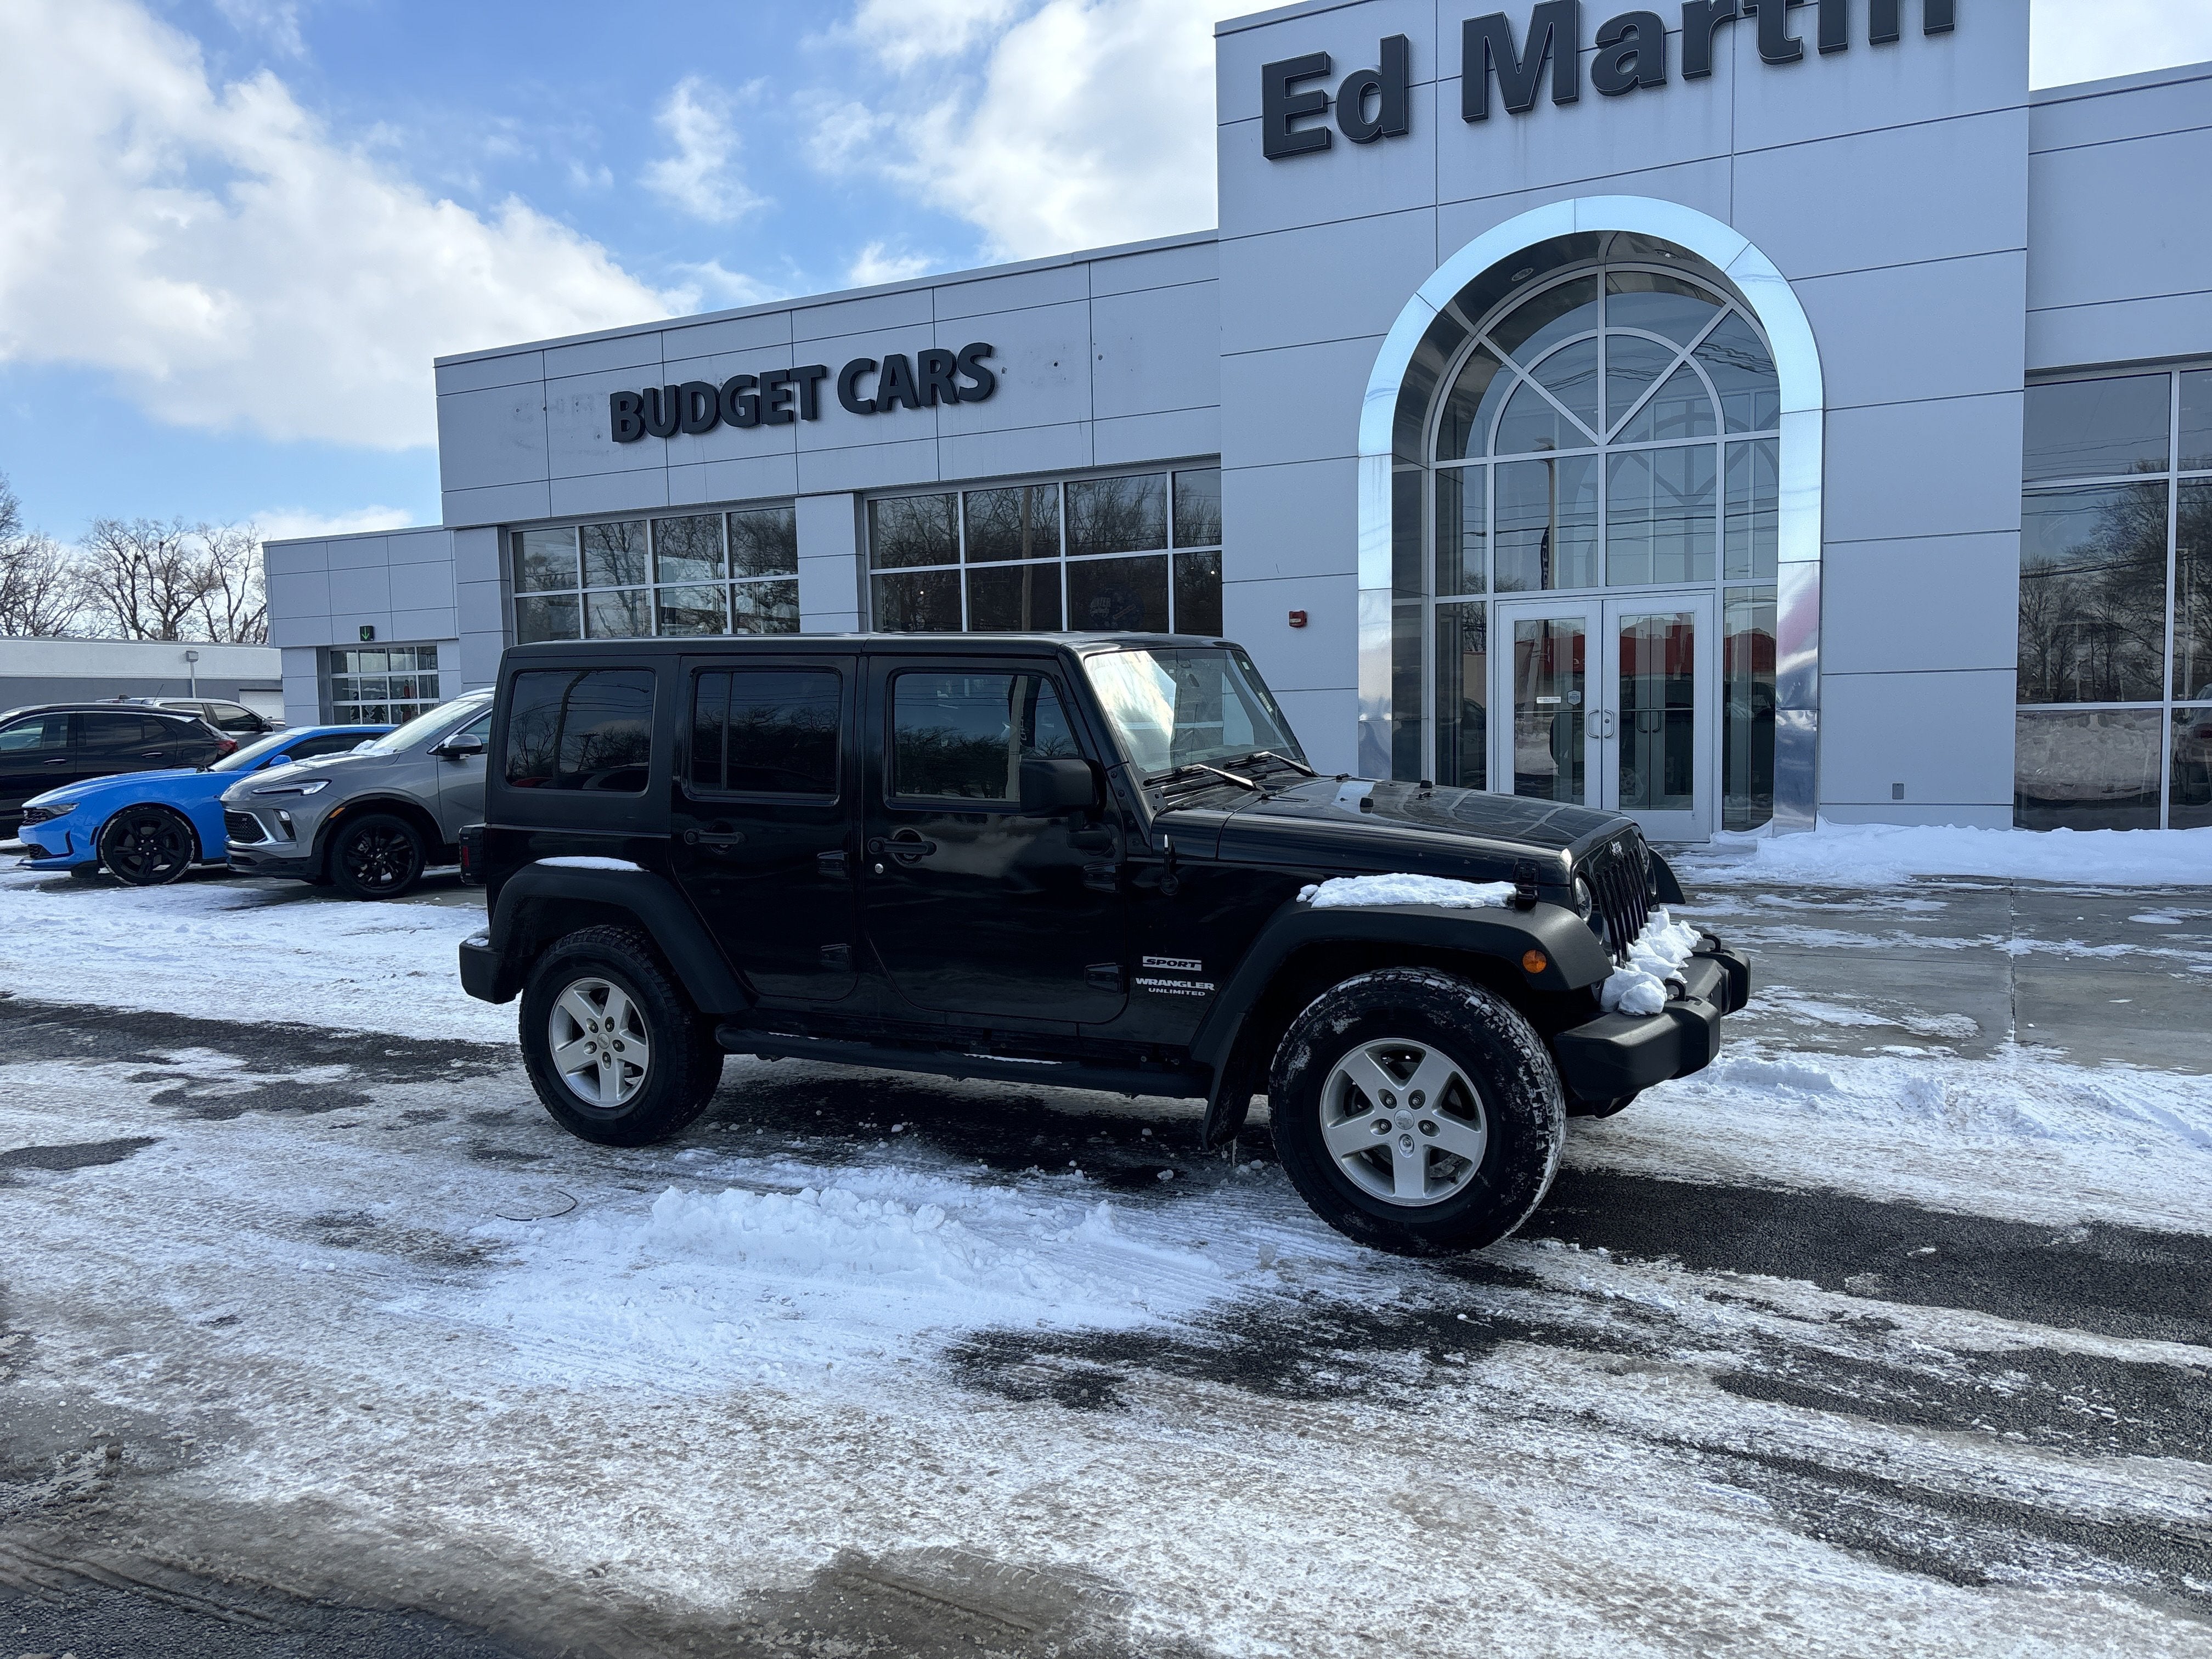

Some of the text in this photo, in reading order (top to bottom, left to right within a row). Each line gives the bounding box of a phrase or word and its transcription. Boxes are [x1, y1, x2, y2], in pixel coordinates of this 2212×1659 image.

[1262, 33, 1409, 160] Ed
[610, 342, 995, 442] BUDGET CARS
[1147, 958, 1198, 968] SPORT
[1136, 978, 1215, 991] WRANGLER
[1148, 988, 1205, 996] UNLIMITED
